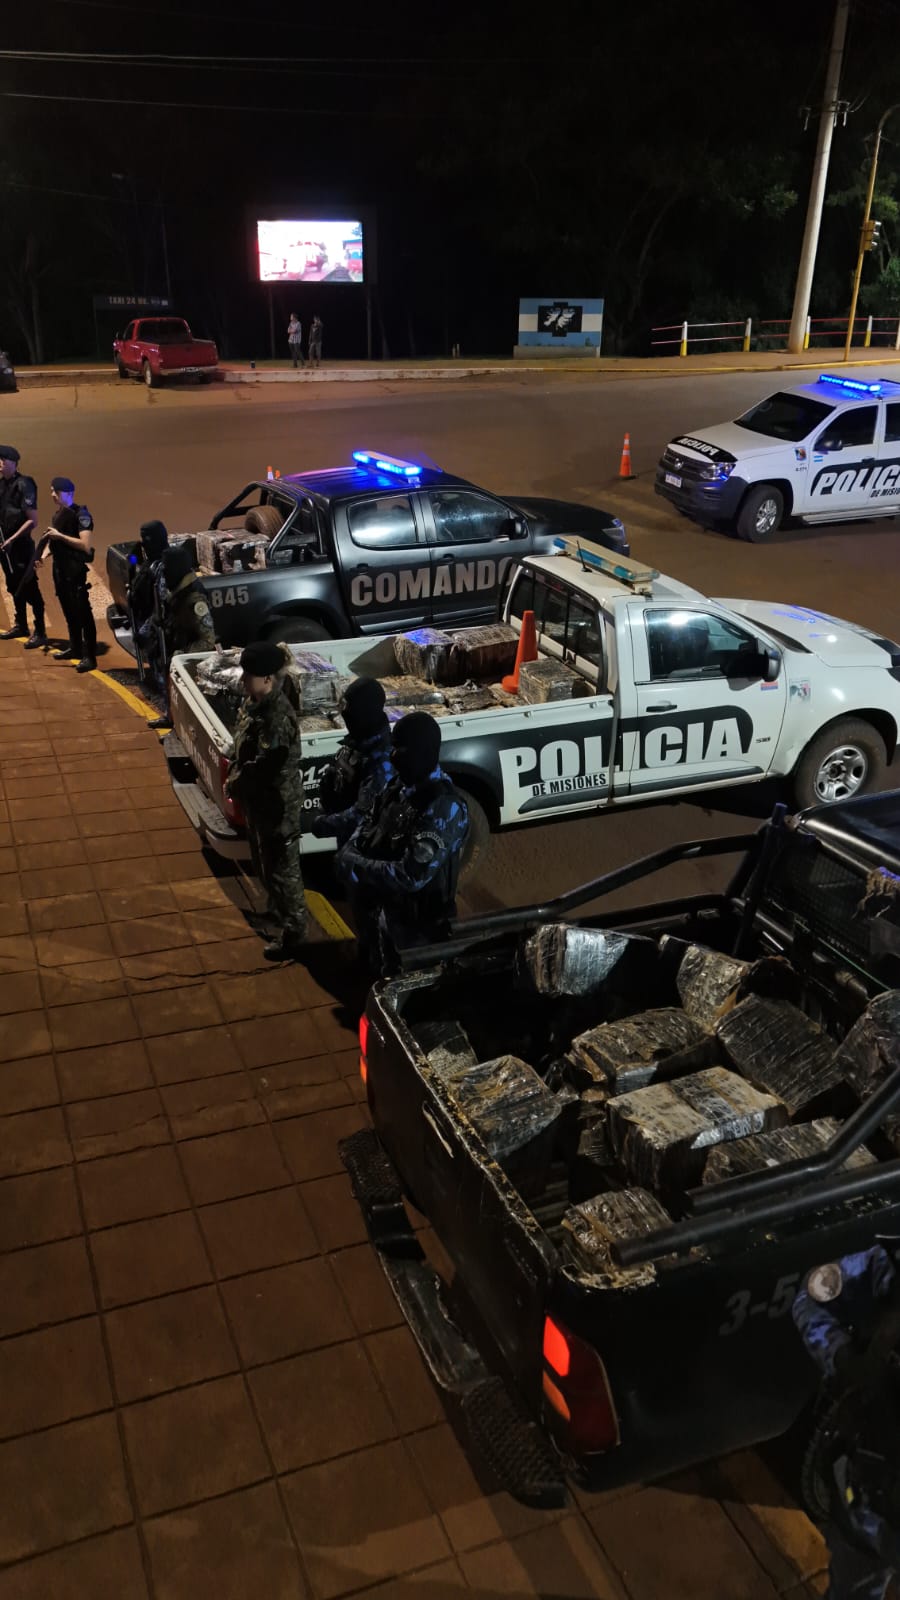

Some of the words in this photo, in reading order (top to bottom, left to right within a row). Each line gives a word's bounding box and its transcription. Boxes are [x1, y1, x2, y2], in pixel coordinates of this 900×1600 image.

[812, 464, 900, 496] POLIC
[499, 717, 744, 788] POLICIA
[532, 783, 547, 797] DE
[549, 773, 606, 794] MISIONES
